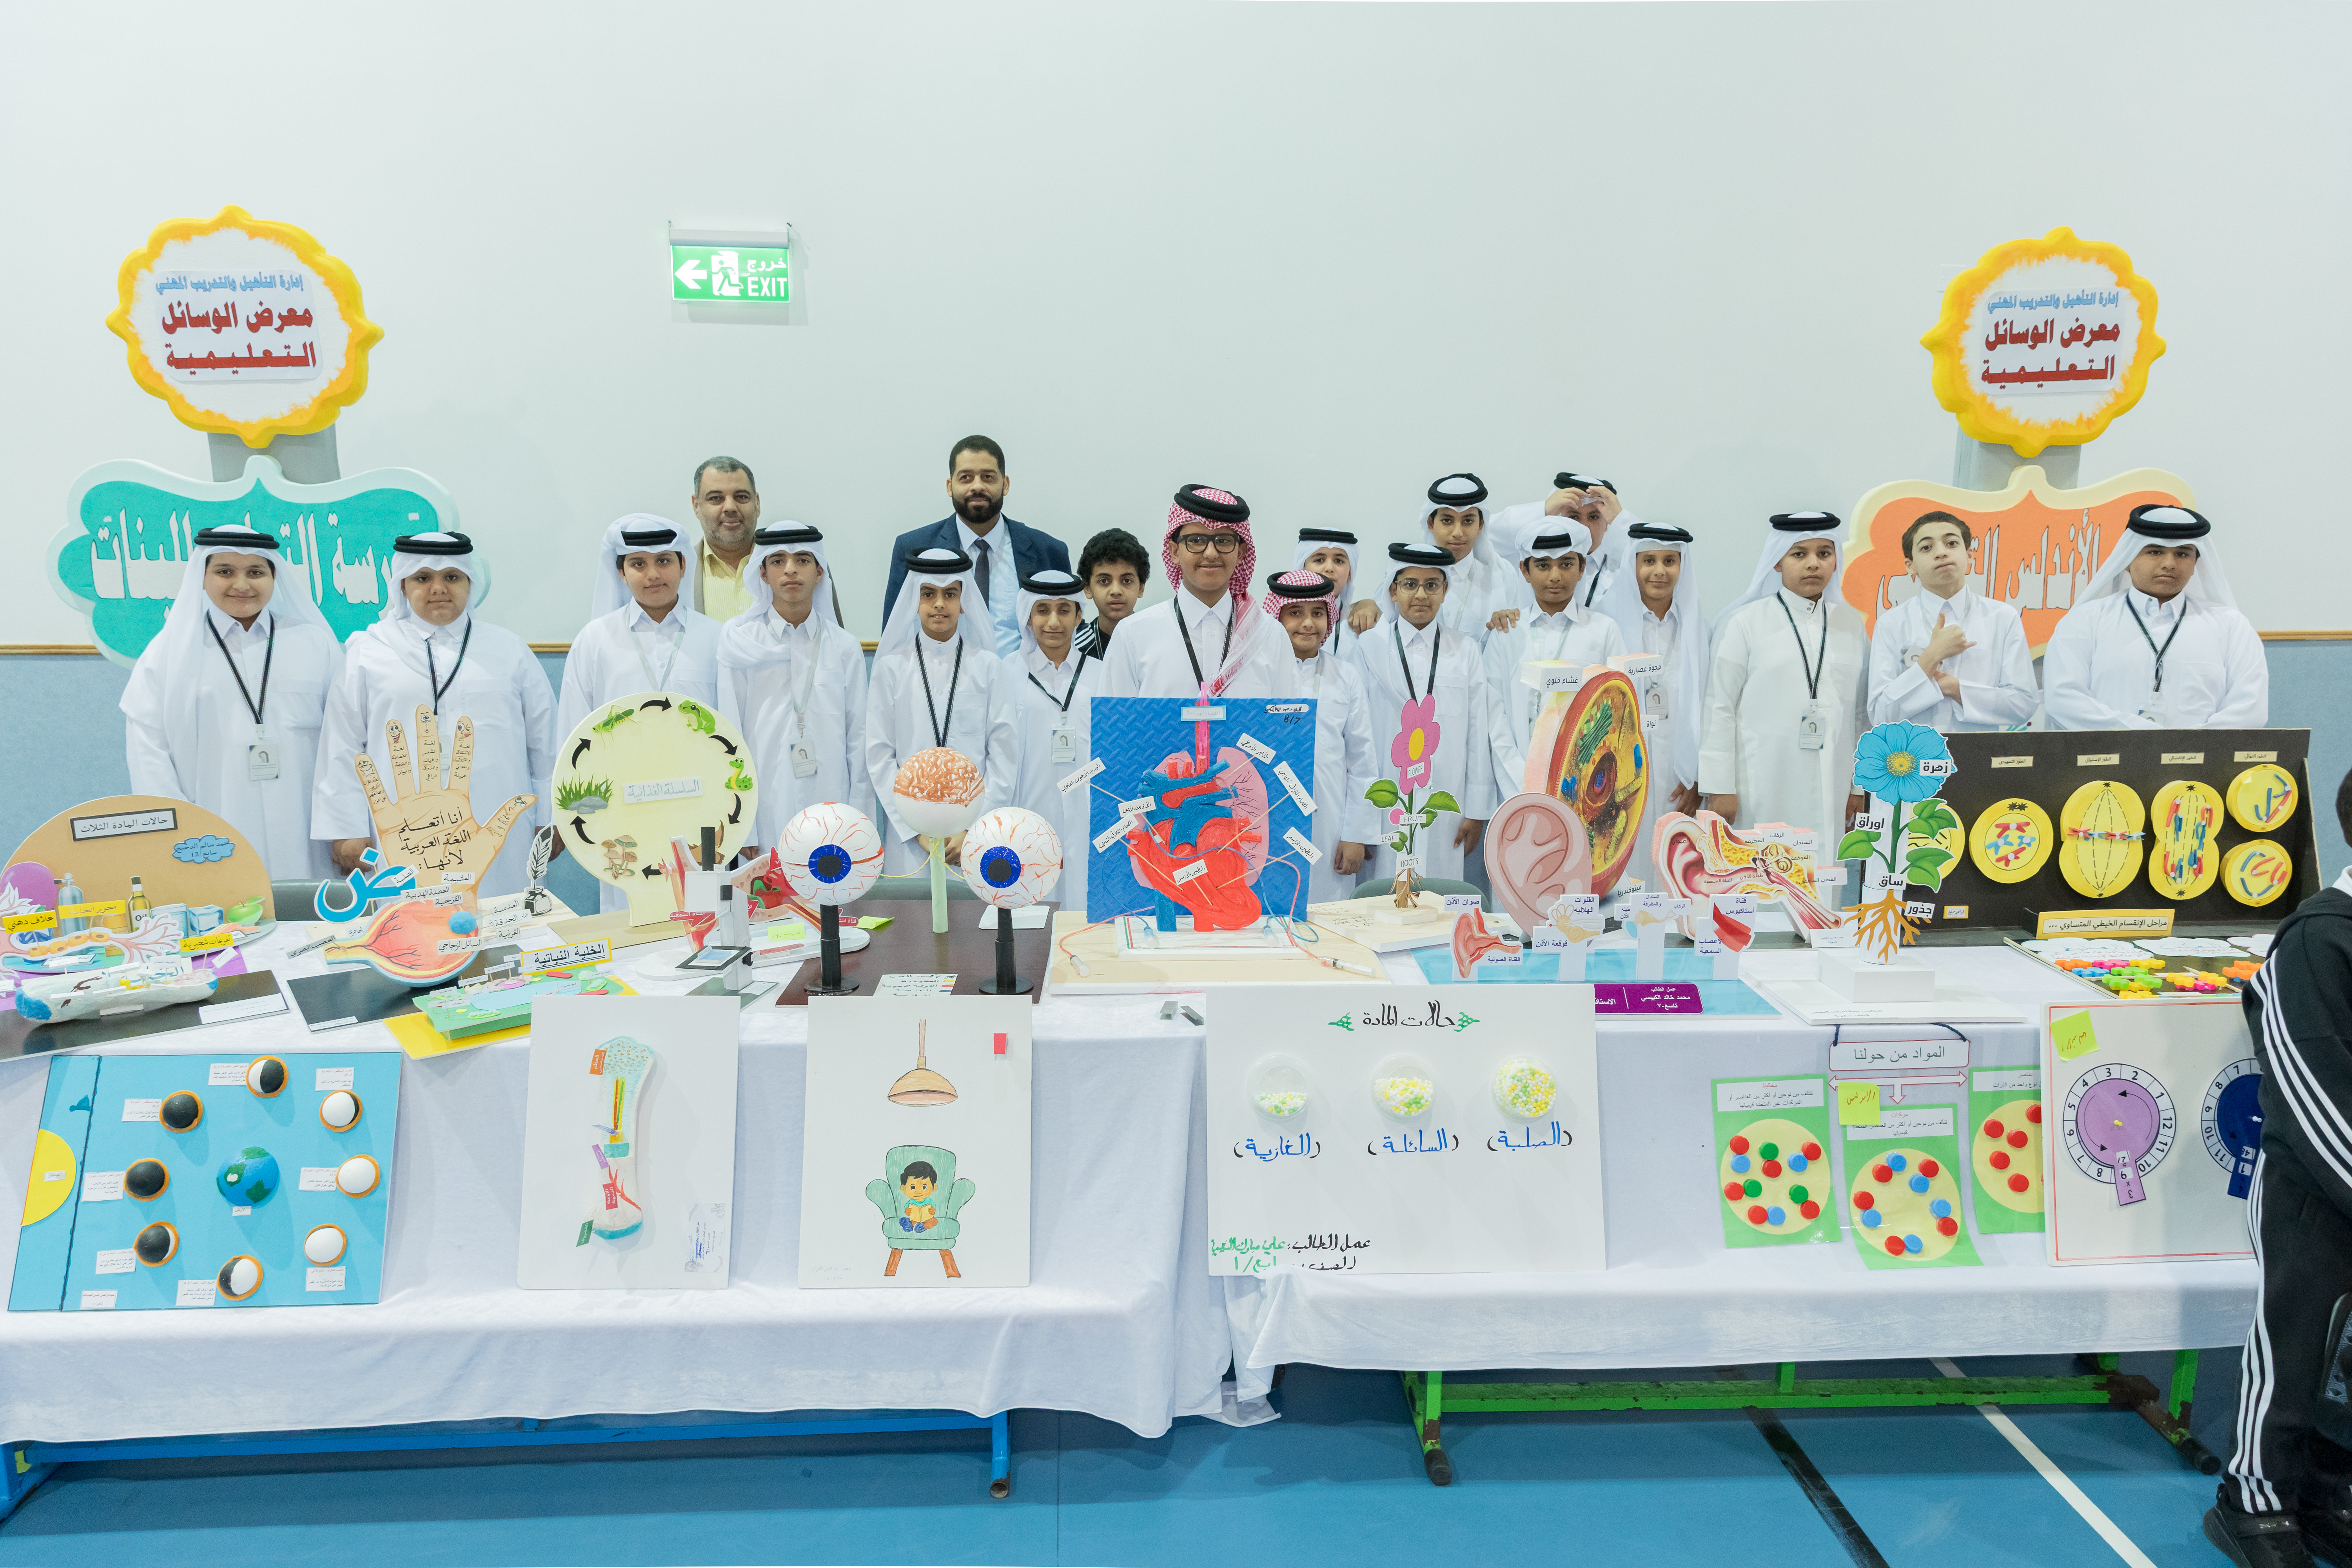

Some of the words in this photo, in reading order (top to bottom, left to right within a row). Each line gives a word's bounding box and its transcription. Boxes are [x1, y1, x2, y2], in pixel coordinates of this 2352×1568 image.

[747, 258, 787, 272] خروج
[156, 275, 187, 295] المهني
[191, 275, 237, 292] والتدريب
[240, 271, 276, 291] التأهيل
[279, 274, 304, 292] إدارة
[748, 277, 787, 297] EXIT
[1987, 295, 2016, 314] المهني
[2019, 293, 2060, 310] والتدريب
[2063, 289, 2096, 309] التأهيل
[2099, 291, 2119, 308] إدارة
[162, 300, 238, 334] الوسائل
[247, 300, 313, 333] معرض
[1985, 318, 2054, 351] الوسائل
[2060, 317, 2120, 348] معرض
[165, 341, 316, 375] التعليمية
[1982, 354, 2115, 389] التعليمية
[1628, 667, 1647, 676] عصارية
[1648, 663, 1662, 673] فجوة
[1546, 677, 1561, 688] خلوي
[1562, 675, 1579, 684] غشاء
[1647, 719, 1656, 728] نواة
[1408, 765, 1423, 777] FLOWER
[1923, 762, 1949, 773] زهرة
[627, 782, 663, 801] الغذائية
[664, 779, 699, 795] السلسلة
[141, 817, 168, 826] حالات
[448, 806, 463, 824] أنا
[80, 822, 109, 833] الثلاث
[112, 818, 138, 829] المادة
[398, 810, 445, 843] أتعلم
[1856, 817, 1885, 830] اوراق
[443, 828, 471, 845] اللغة
[401, 835, 440, 855] العربية
[1401, 858, 1419, 867] ROOTS
[396, 867, 415, 884] الصلبة
[443, 874, 471, 884] المشيمة
[1879, 875, 1904, 887] ساق
[405, 889, 429, 899] الهدبية
[428, 886, 450, 896] العضلة
[1617, 884, 1642, 897] ميتوكندريا
[435, 895, 461, 905] القزحية
[494, 899, 519, 914] العدسة
[95, 905, 116, 914] محور
[1726, 906, 1755, 915] أستاكيوس
[1907, 904, 1933, 917] جذور
[7, 918, 29, 931] دهني
[31, 915, 54, 924] غلاف
[495, 914, 518, 926] الحدقة
[2060, 920, 2091, 931] المتساوي
[2092, 919, 2118, 930] الخيطي
[2119, 919, 2146, 929] الإنقسام
[2147, 919, 2167, 927] مراحل
[498, 927, 521, 940] القرنية
[312, 935, 336, 949] العصب
[438, 941, 462, 951] الزجاجي
[461, 939, 482, 949] السائل
[290, 944, 311, 958] البصري
[574, 943, 604, 960] الخلية
[534, 949, 570, 967] النباتية
[1363, 1003, 1398, 1027] المادة
[1400, 1000, 1456, 1027] حالات
[1853, 1048, 1885, 1063] حولنا
[1889, 1050, 1907, 1062] من
[1912, 1045, 1945, 1062] المواد
[2105, 1067, 2112, 1077] 3
[2131, 1070, 2139, 1080] 2
[2233, 1065, 2240, 1074] 7
[2082, 1078, 2089, 1088] 4
[2215, 1081, 2223, 1089] 8
[2155, 1091, 2165, 1099] 1
[2067, 1102, 2076, 1111] 5
[2162, 1116, 2173, 1130] 12
[2204, 1126, 2215, 1141] 10
[2155, 1140, 2169, 1153] 11
[2076, 1154, 2085, 1163] 7
[2214, 1148, 2227, 1162] 11
[2138, 1159, 2152, 1172] 10
[2096, 1168, 2103, 1177] 8
